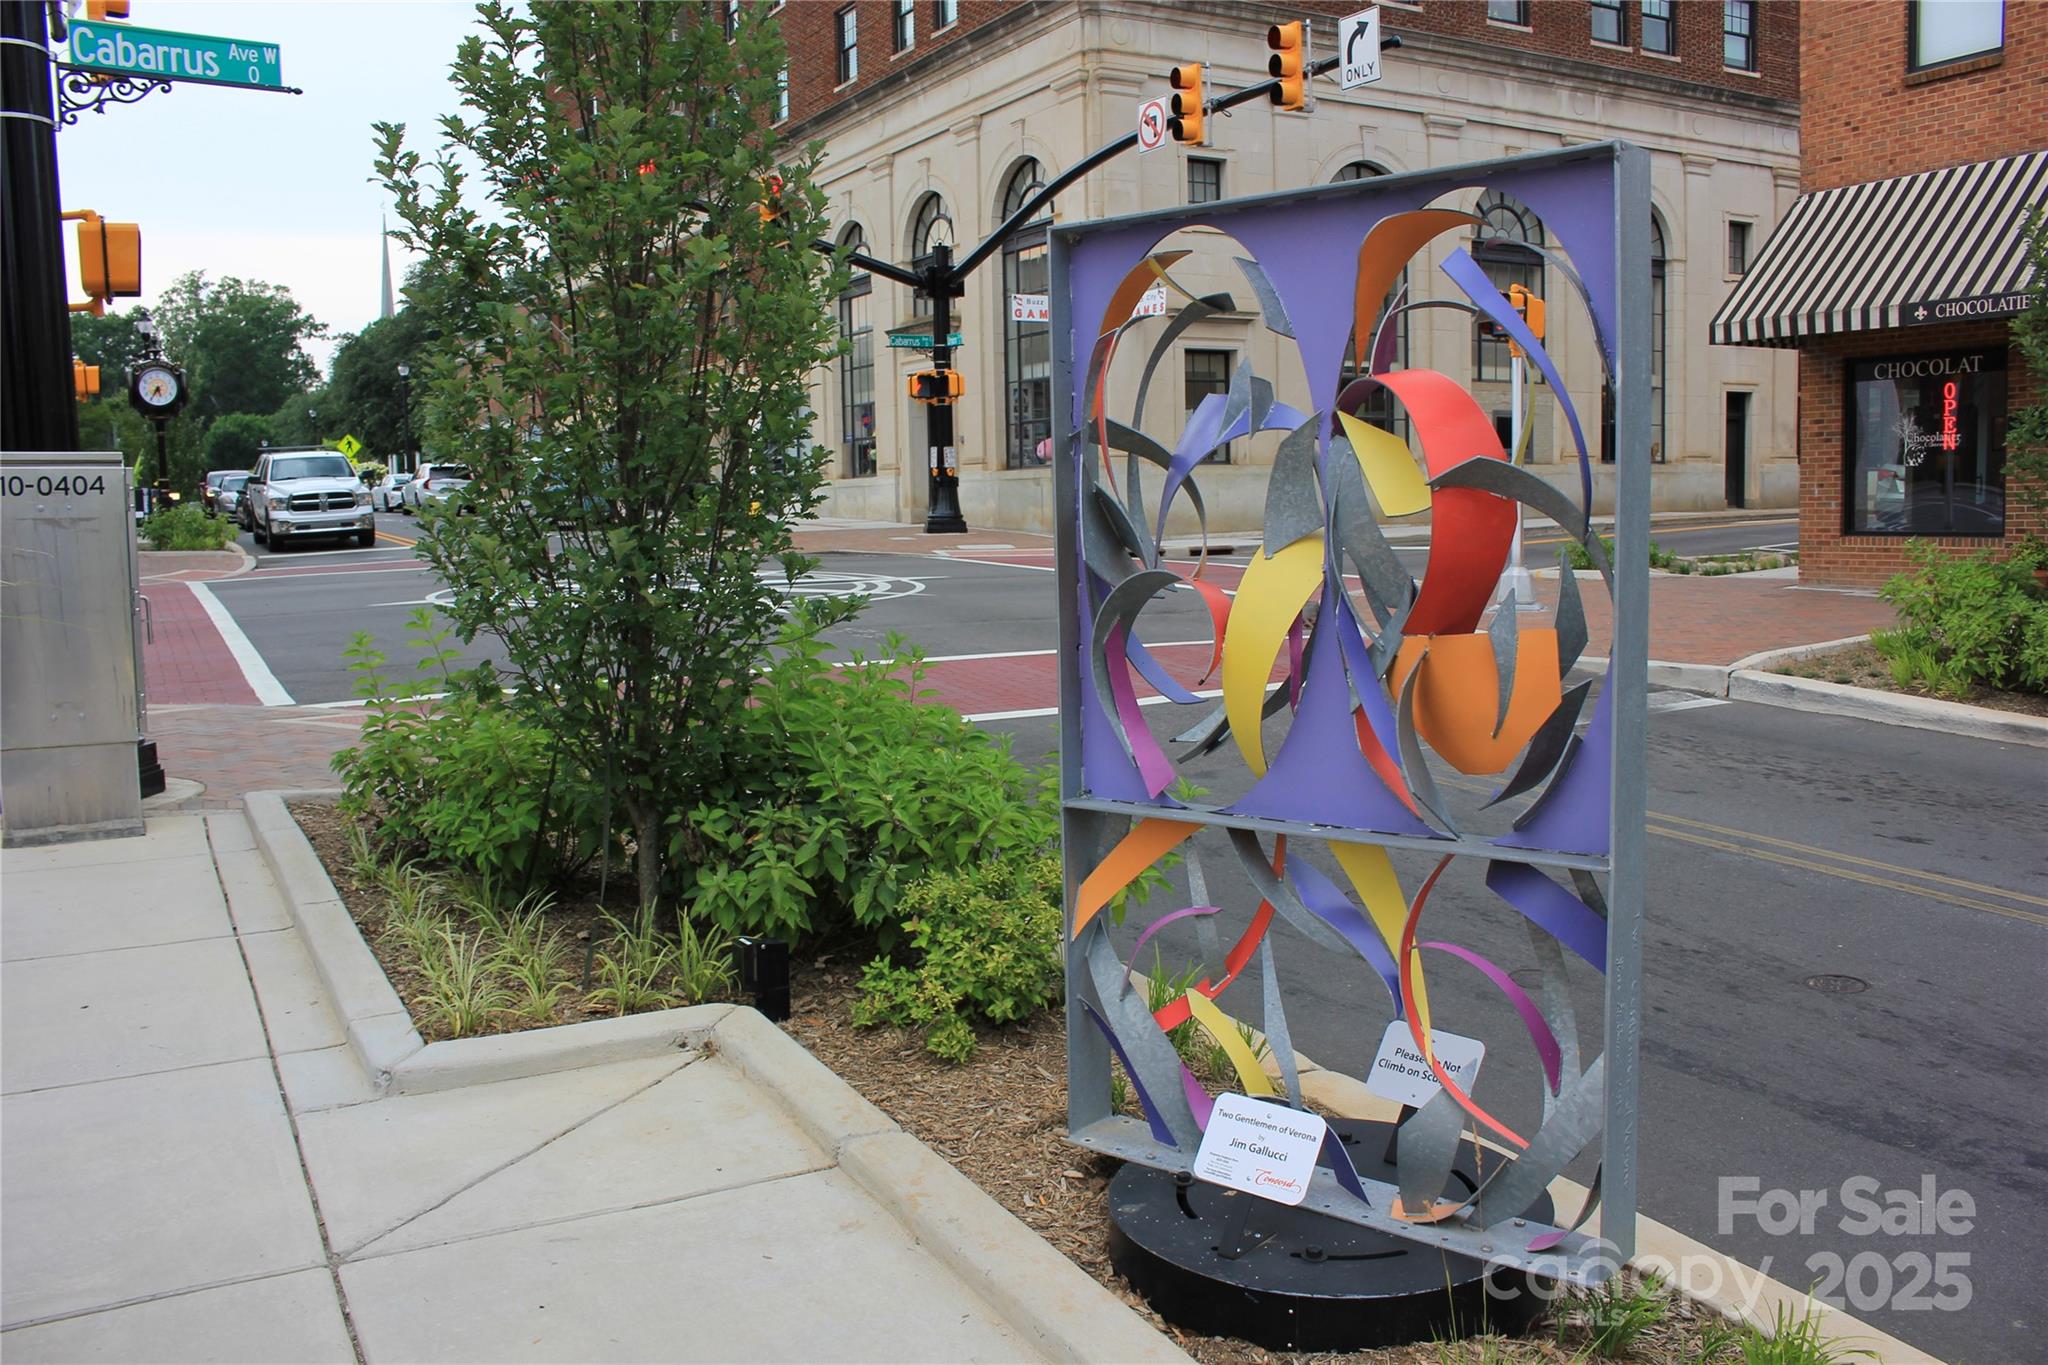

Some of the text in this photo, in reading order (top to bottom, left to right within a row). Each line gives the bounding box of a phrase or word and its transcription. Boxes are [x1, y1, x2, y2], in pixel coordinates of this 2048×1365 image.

[72, 26, 277, 77] Cabarrus Ave W
[1346, 61, 1375, 82] ONLY
[1026, 297, 1044, 306] Buzz
[1134, 302, 1165, 316] AMES
[1874, 355, 1984, 380] CHOCOLAT
[1943, 381, 1958, 451] OPEN
[1906, 431, 1962, 443] Chocolar
[1378, 1058, 1443, 1086] Climb on Scu
[1442, 1060, 1461, 1073] Not
[1218, 1108, 1317, 1143] Two Gentlemen of Verona
[1229, 1138, 1288, 1162] Jim Gallucci
